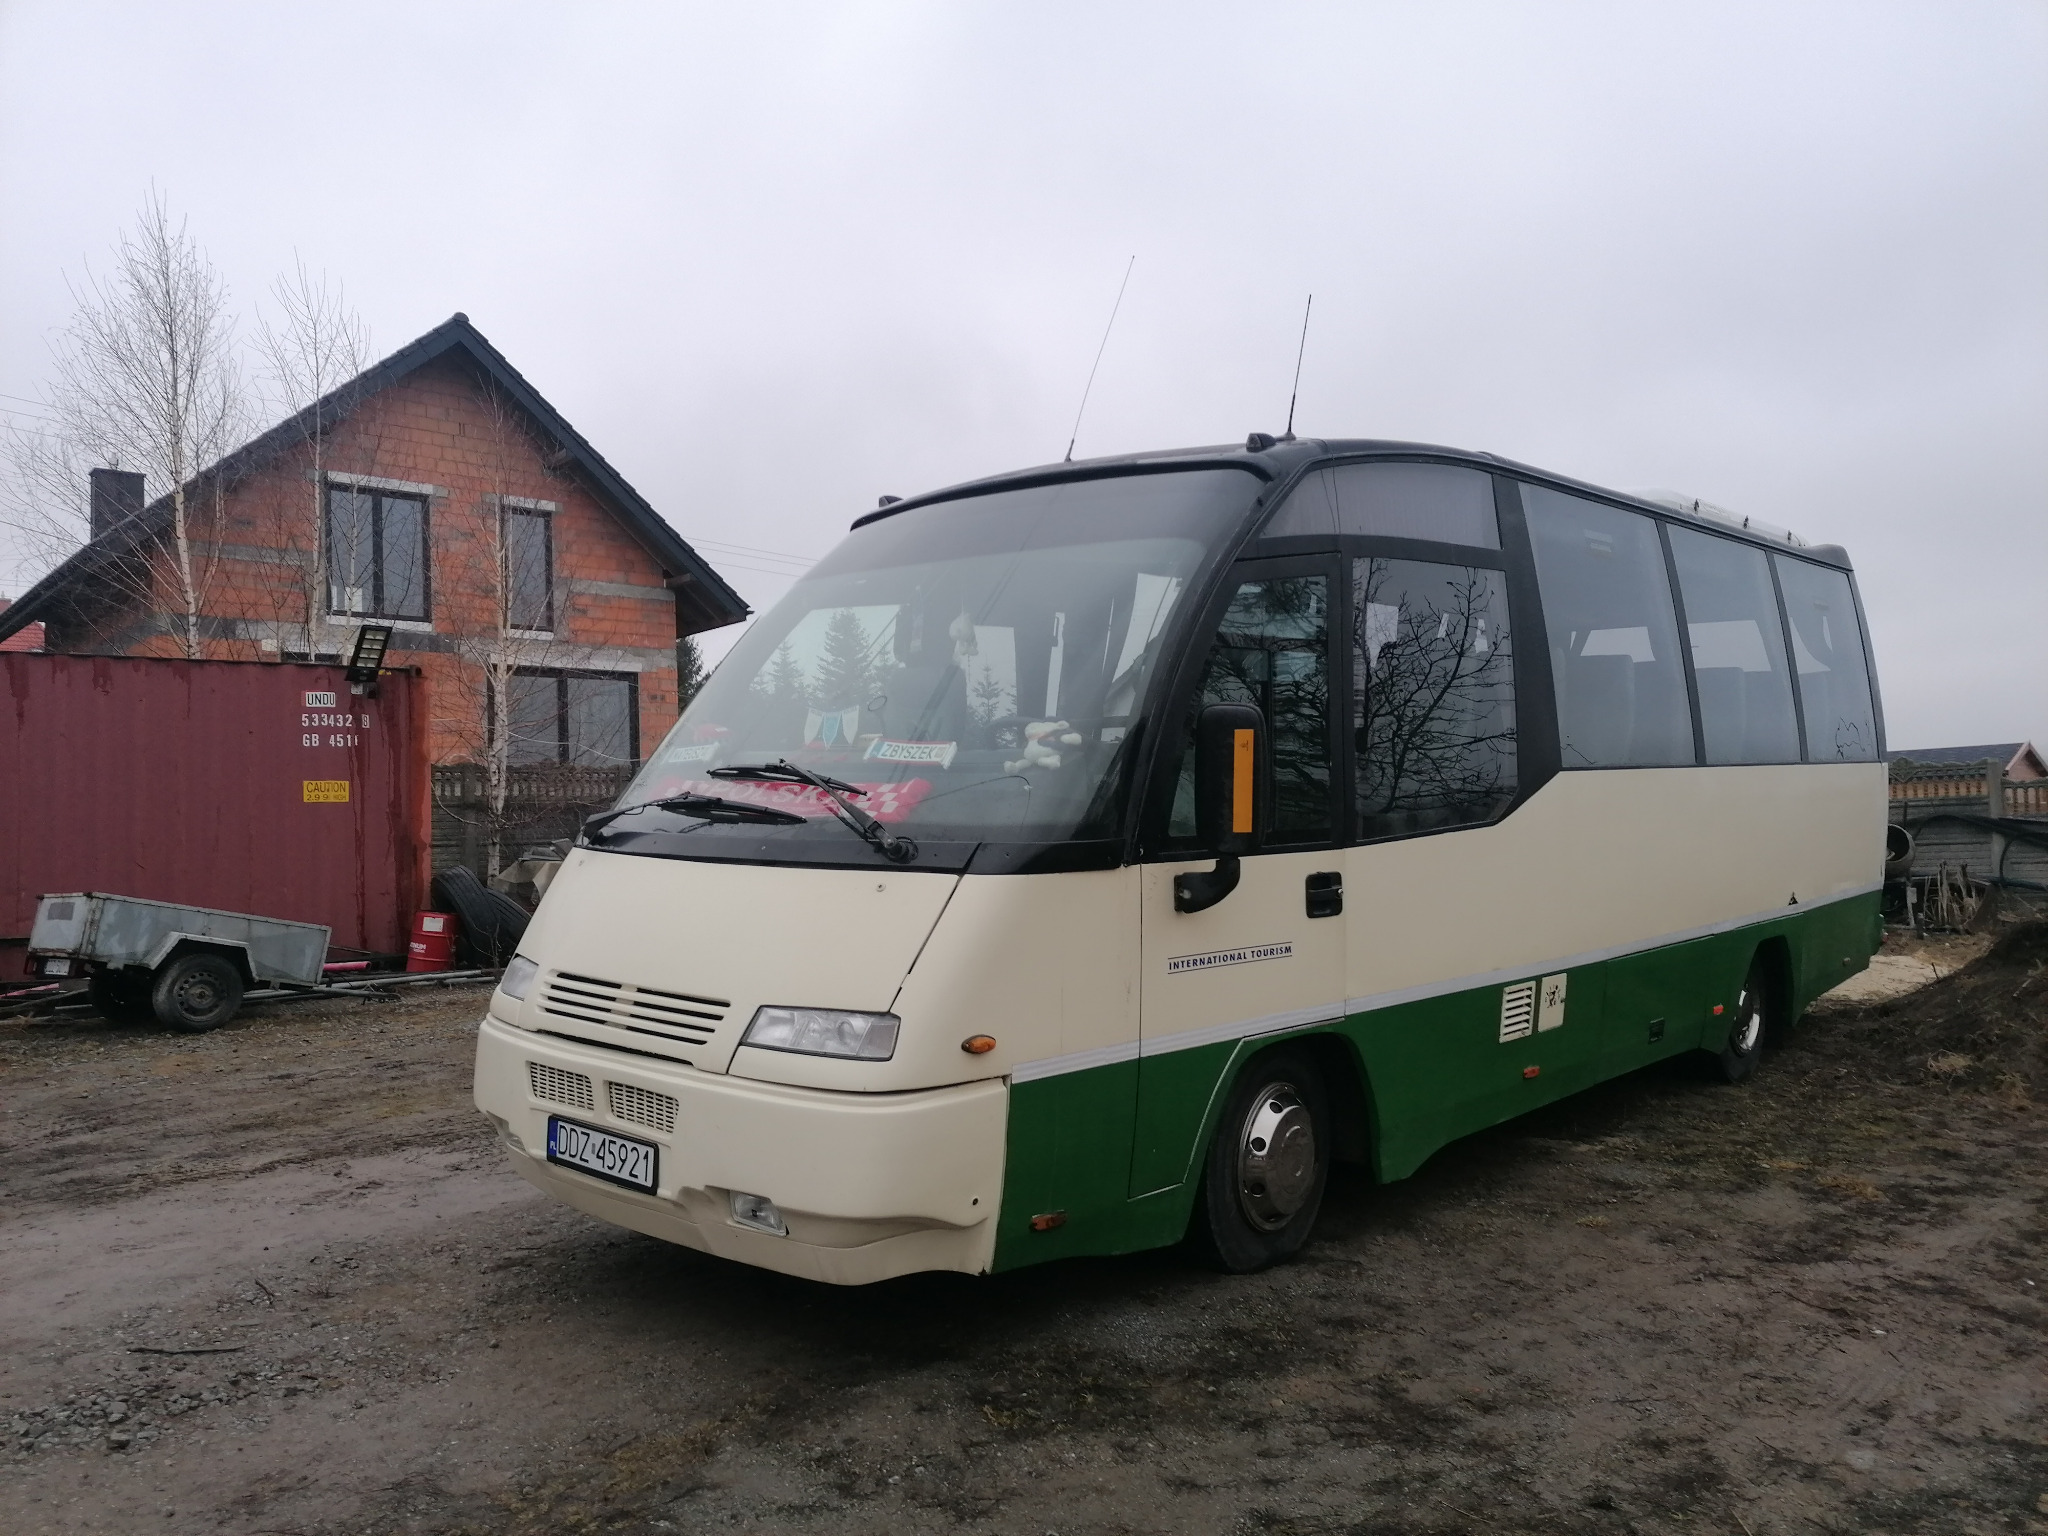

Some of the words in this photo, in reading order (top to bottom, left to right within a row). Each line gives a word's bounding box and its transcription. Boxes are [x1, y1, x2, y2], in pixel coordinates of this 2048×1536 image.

[307, 693, 335, 706] UNDU
[301, 713, 353, 727] 533432
[302, 733, 320, 747] GB
[881, 743, 937, 760] ZBYSZEK
[306, 781, 347, 793] CAUTION
[1168, 951, 1248, 971] INTERNATIONAL
[1251, 945, 1293, 960] TOURISM
